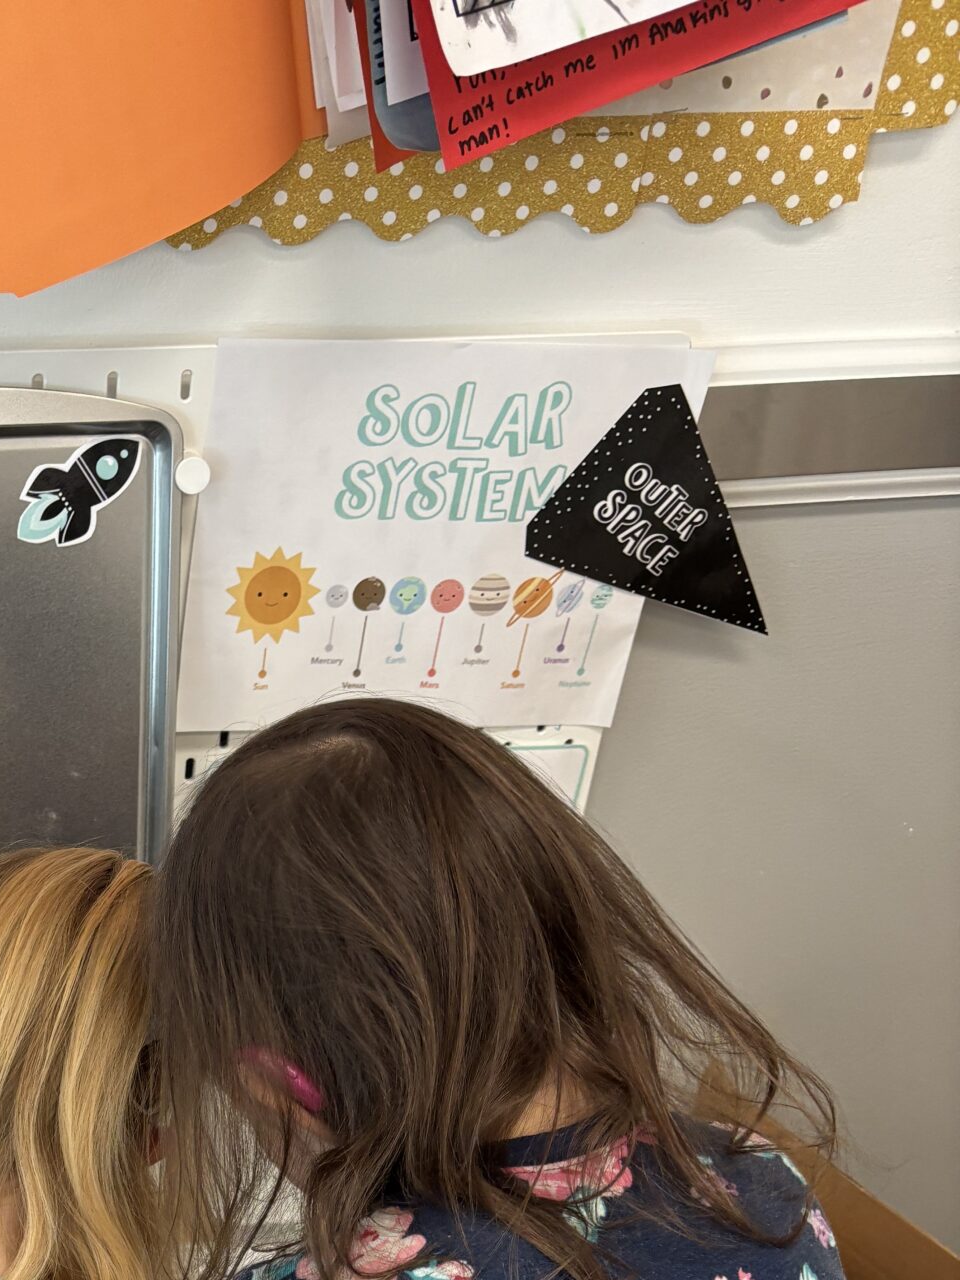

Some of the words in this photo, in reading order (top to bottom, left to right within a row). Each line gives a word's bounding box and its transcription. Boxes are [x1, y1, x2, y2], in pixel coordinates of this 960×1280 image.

[506, 71, 554, 105] catch
[564, 53, 597, 79] me
[458, 118, 511, 156] man!
[357, 381, 573, 457] SOLAR
[334, 456, 568, 522] SYSTEM
[624, 462, 709, 542] OUTER
[593, 489, 680, 577] SPACE
[419, 680, 440, 690] Mars
